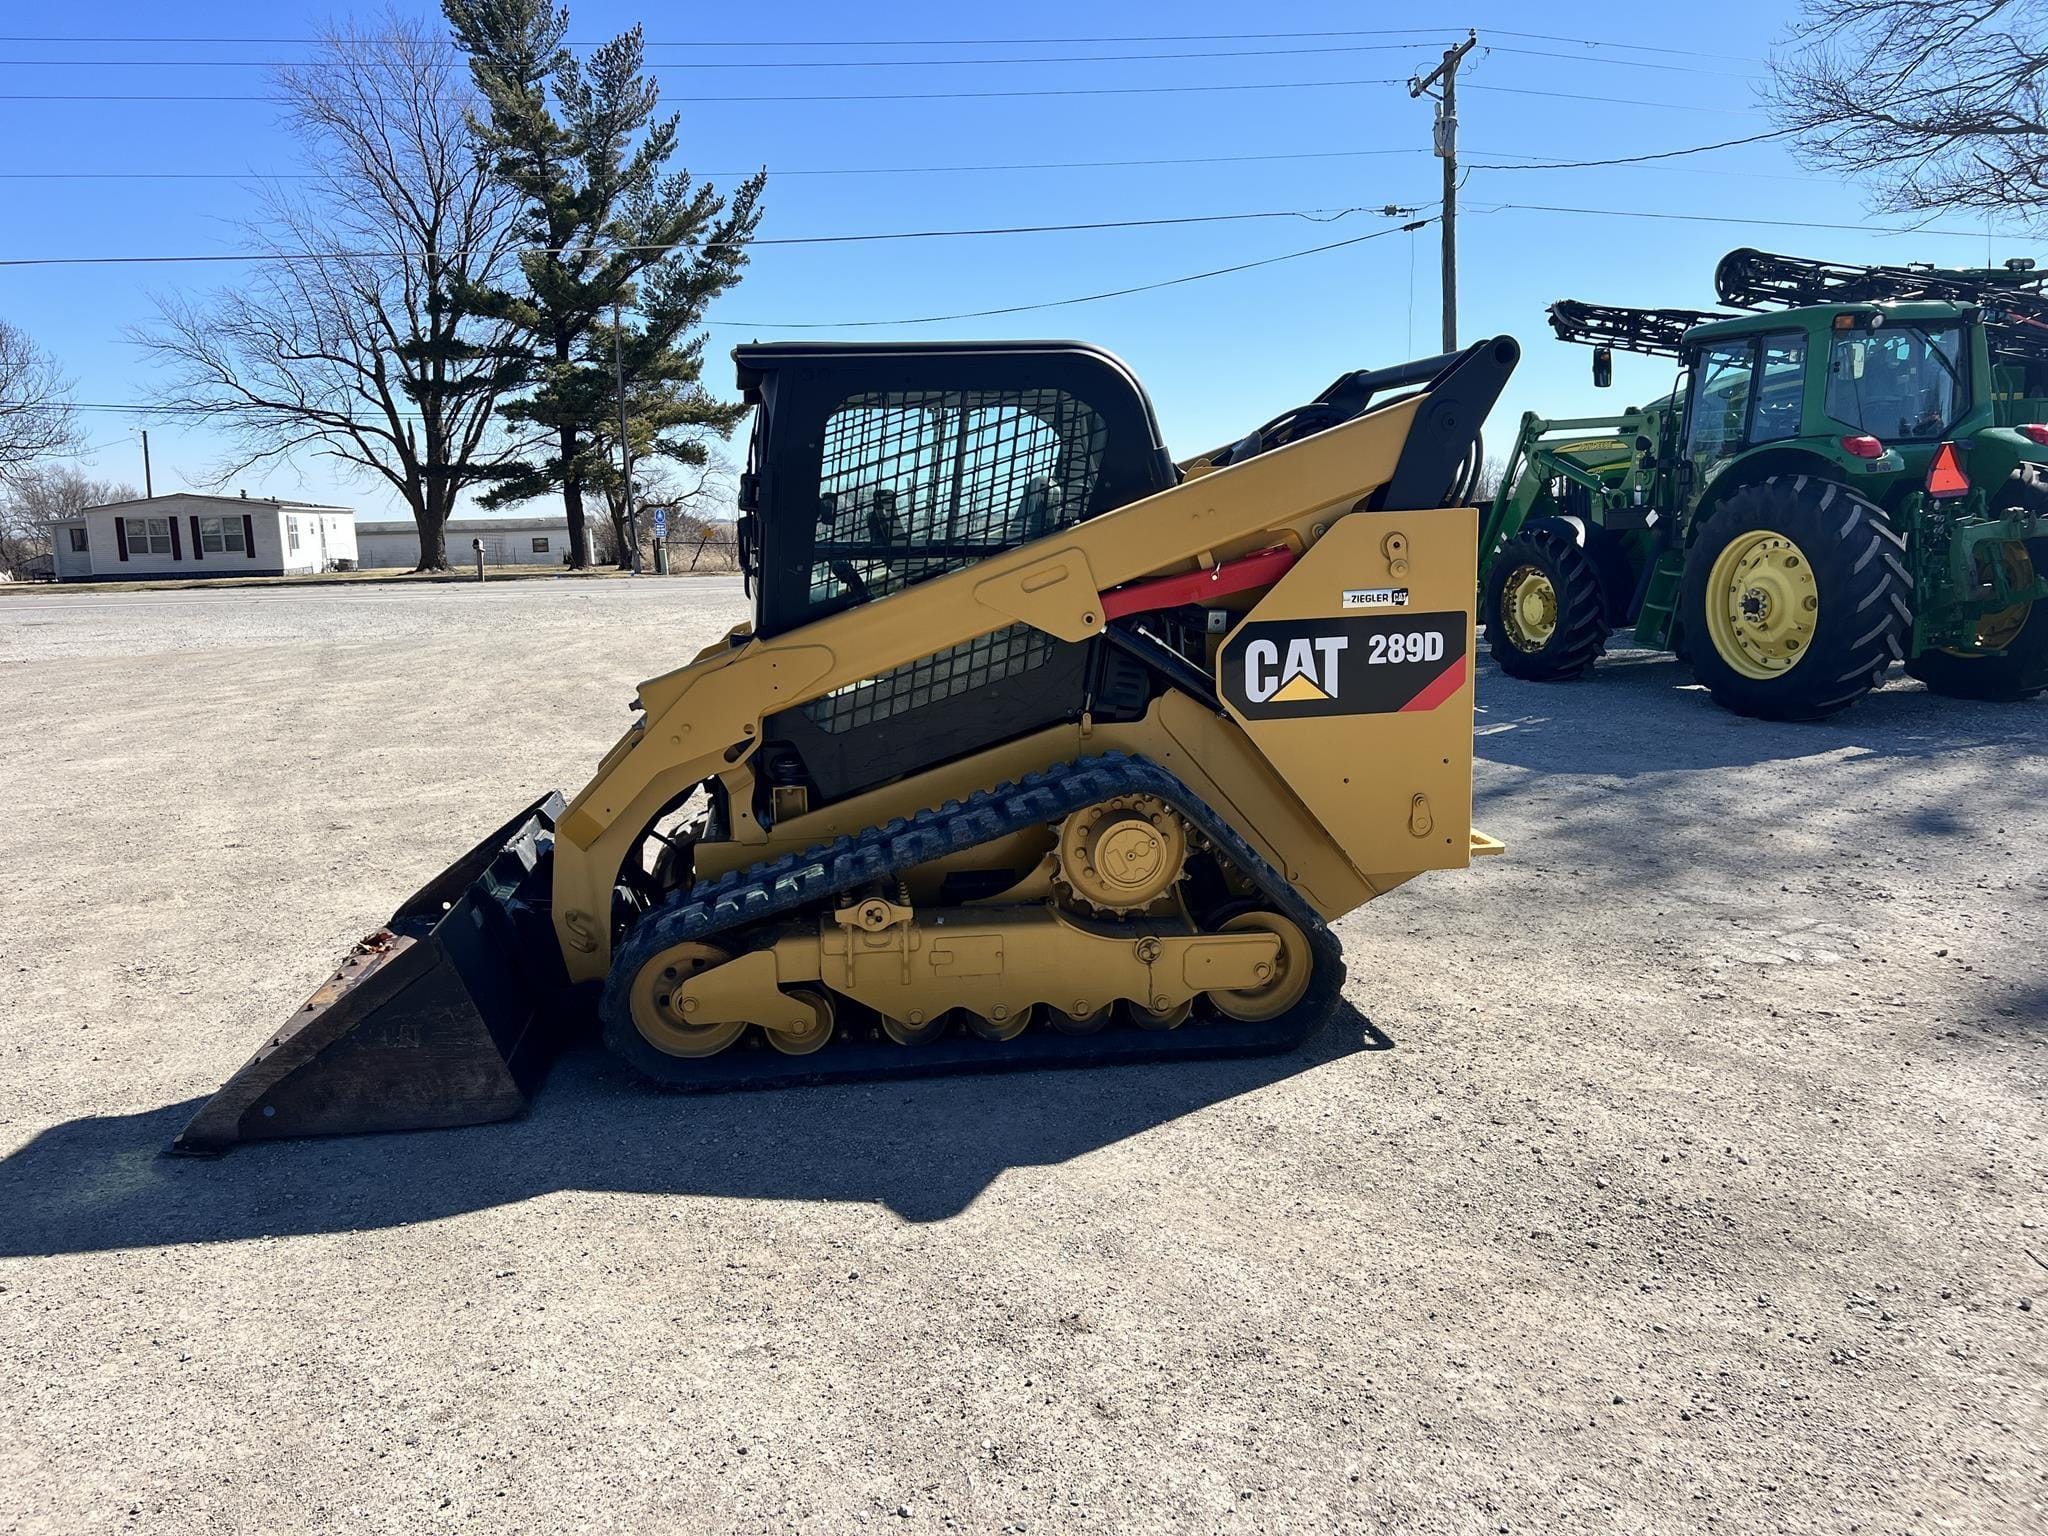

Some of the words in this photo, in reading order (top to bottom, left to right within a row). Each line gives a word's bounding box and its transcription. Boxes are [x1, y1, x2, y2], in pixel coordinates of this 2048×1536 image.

[1351, 594, 1389, 603] ZIEGLER
[1393, 592, 1408, 602] CAT
[1245, 636, 1348, 703] CAT
[1368, 631, 1444, 664] 289D
